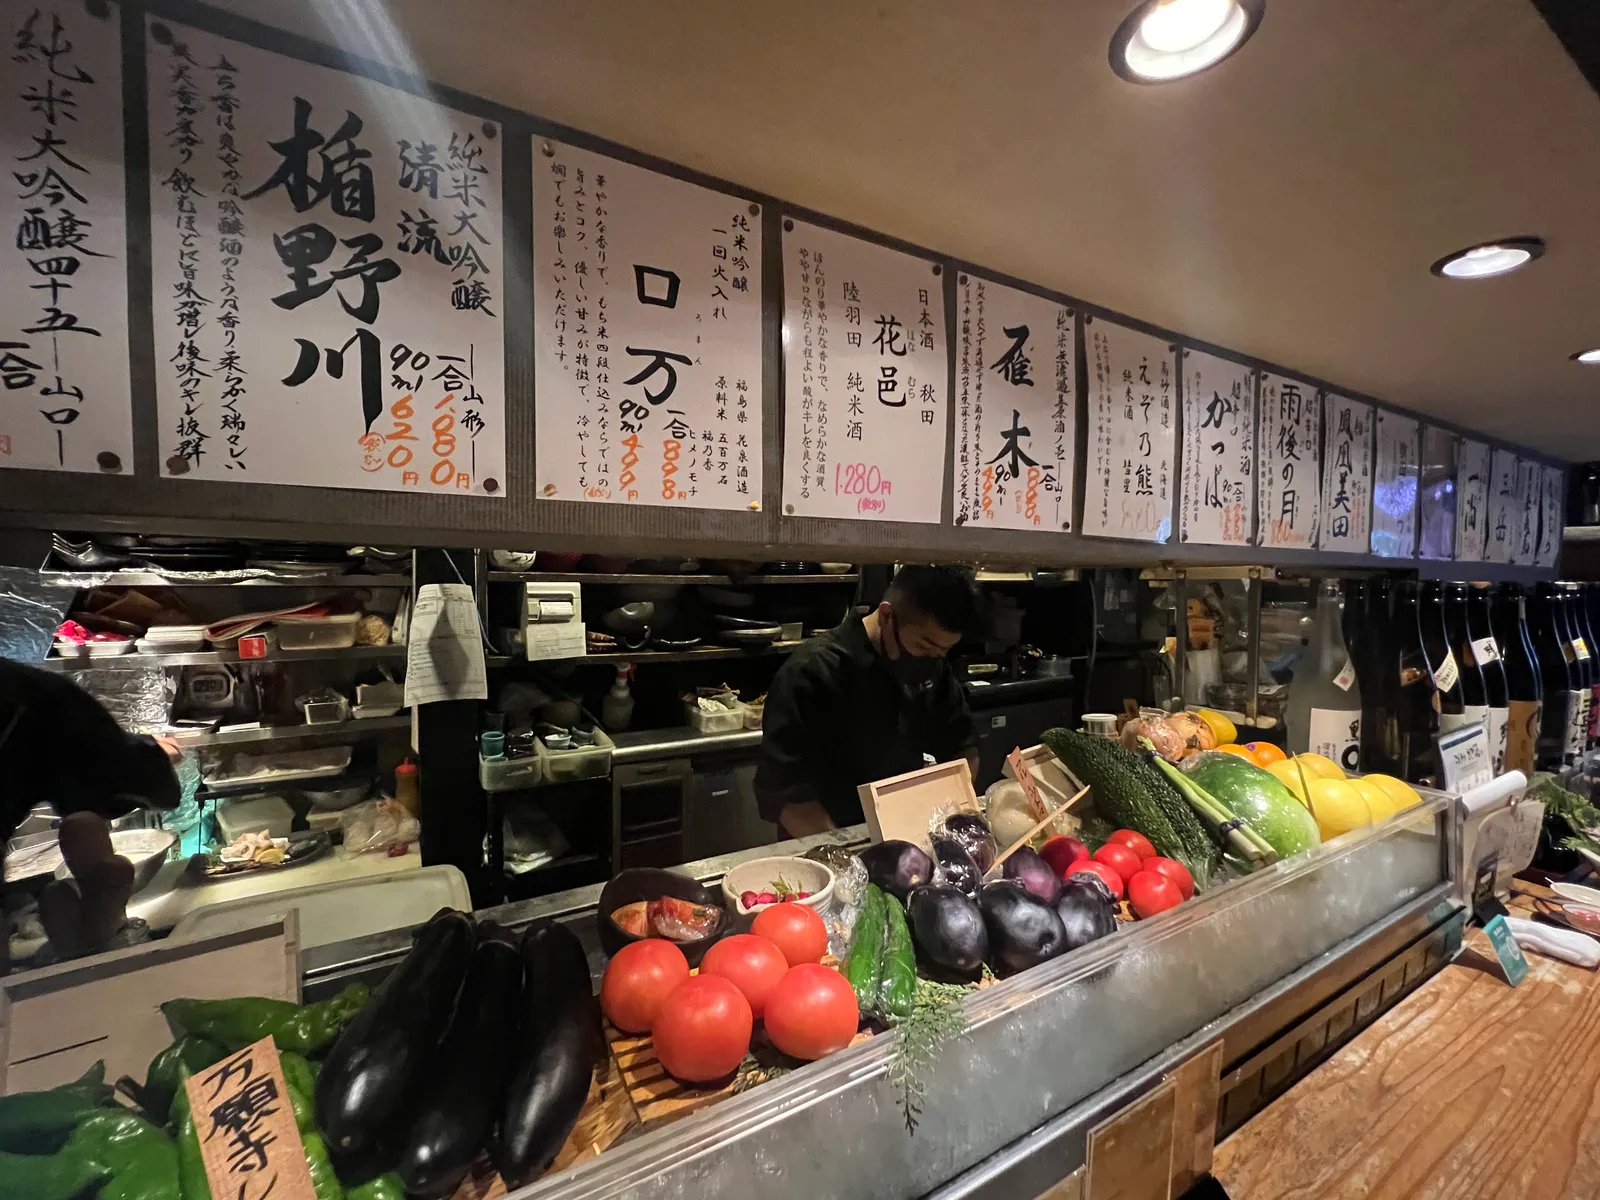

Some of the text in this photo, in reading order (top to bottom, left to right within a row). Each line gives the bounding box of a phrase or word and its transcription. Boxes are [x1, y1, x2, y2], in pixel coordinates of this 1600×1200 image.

[396, 137, 453, 266] 清流
[443, 132, 497, 317] 純米大吟醸
[731, 214, 750, 292] 純米吟醸
[240, 95, 402, 434] 楯野川
[710, 227, 729, 320] 一回火入れ
[431, 355, 470, 392] 一合
[623, 263, 693, 406] 口万
[843, 281, 865, 442] 陸羽田 純米酒
[871, 314, 907, 407] 花邑
[918, 288, 937, 426] 日本酒 秋田
[662, 409, 690, 439] 一合
[701, 430, 715, 472] 福乃香
[714, 375, 729, 486] 原料米 五百万石
[735, 379, 750, 495] 福島県 花泉酒造
[1122, 368, 1134, 420] 純米酒
[1201, 390, 1233, 509] かっぱ
[688, 429, 699, 497] ヒメノモチ
[1275, 383, 1302, 530] 雨後の月
[1331, 407, 1354, 538] 鳳凰美田
